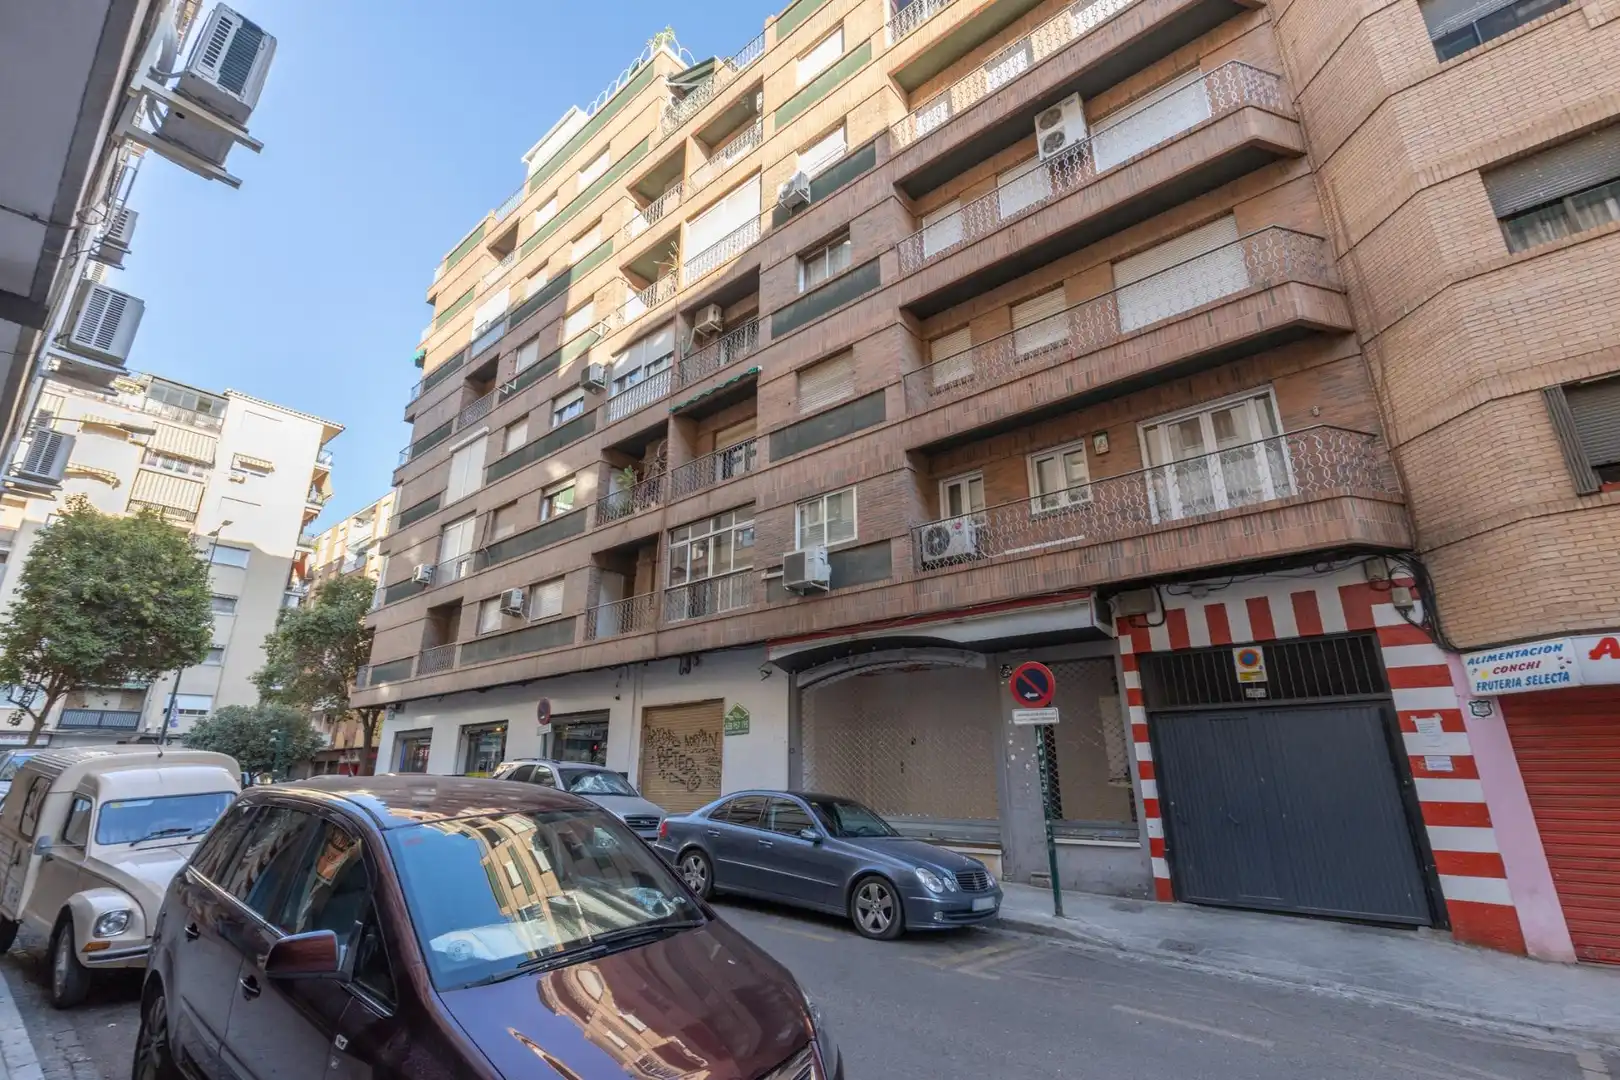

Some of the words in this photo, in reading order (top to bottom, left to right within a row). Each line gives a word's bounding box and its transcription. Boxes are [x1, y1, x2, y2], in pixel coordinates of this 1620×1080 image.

[1467, 643, 1564, 666] ALIMENTACION
[1492, 660, 1542, 675] CONCHI
[1476, 677, 1522, 692] FRUTERIA
[1525, 671, 1571, 687] SELECTA
